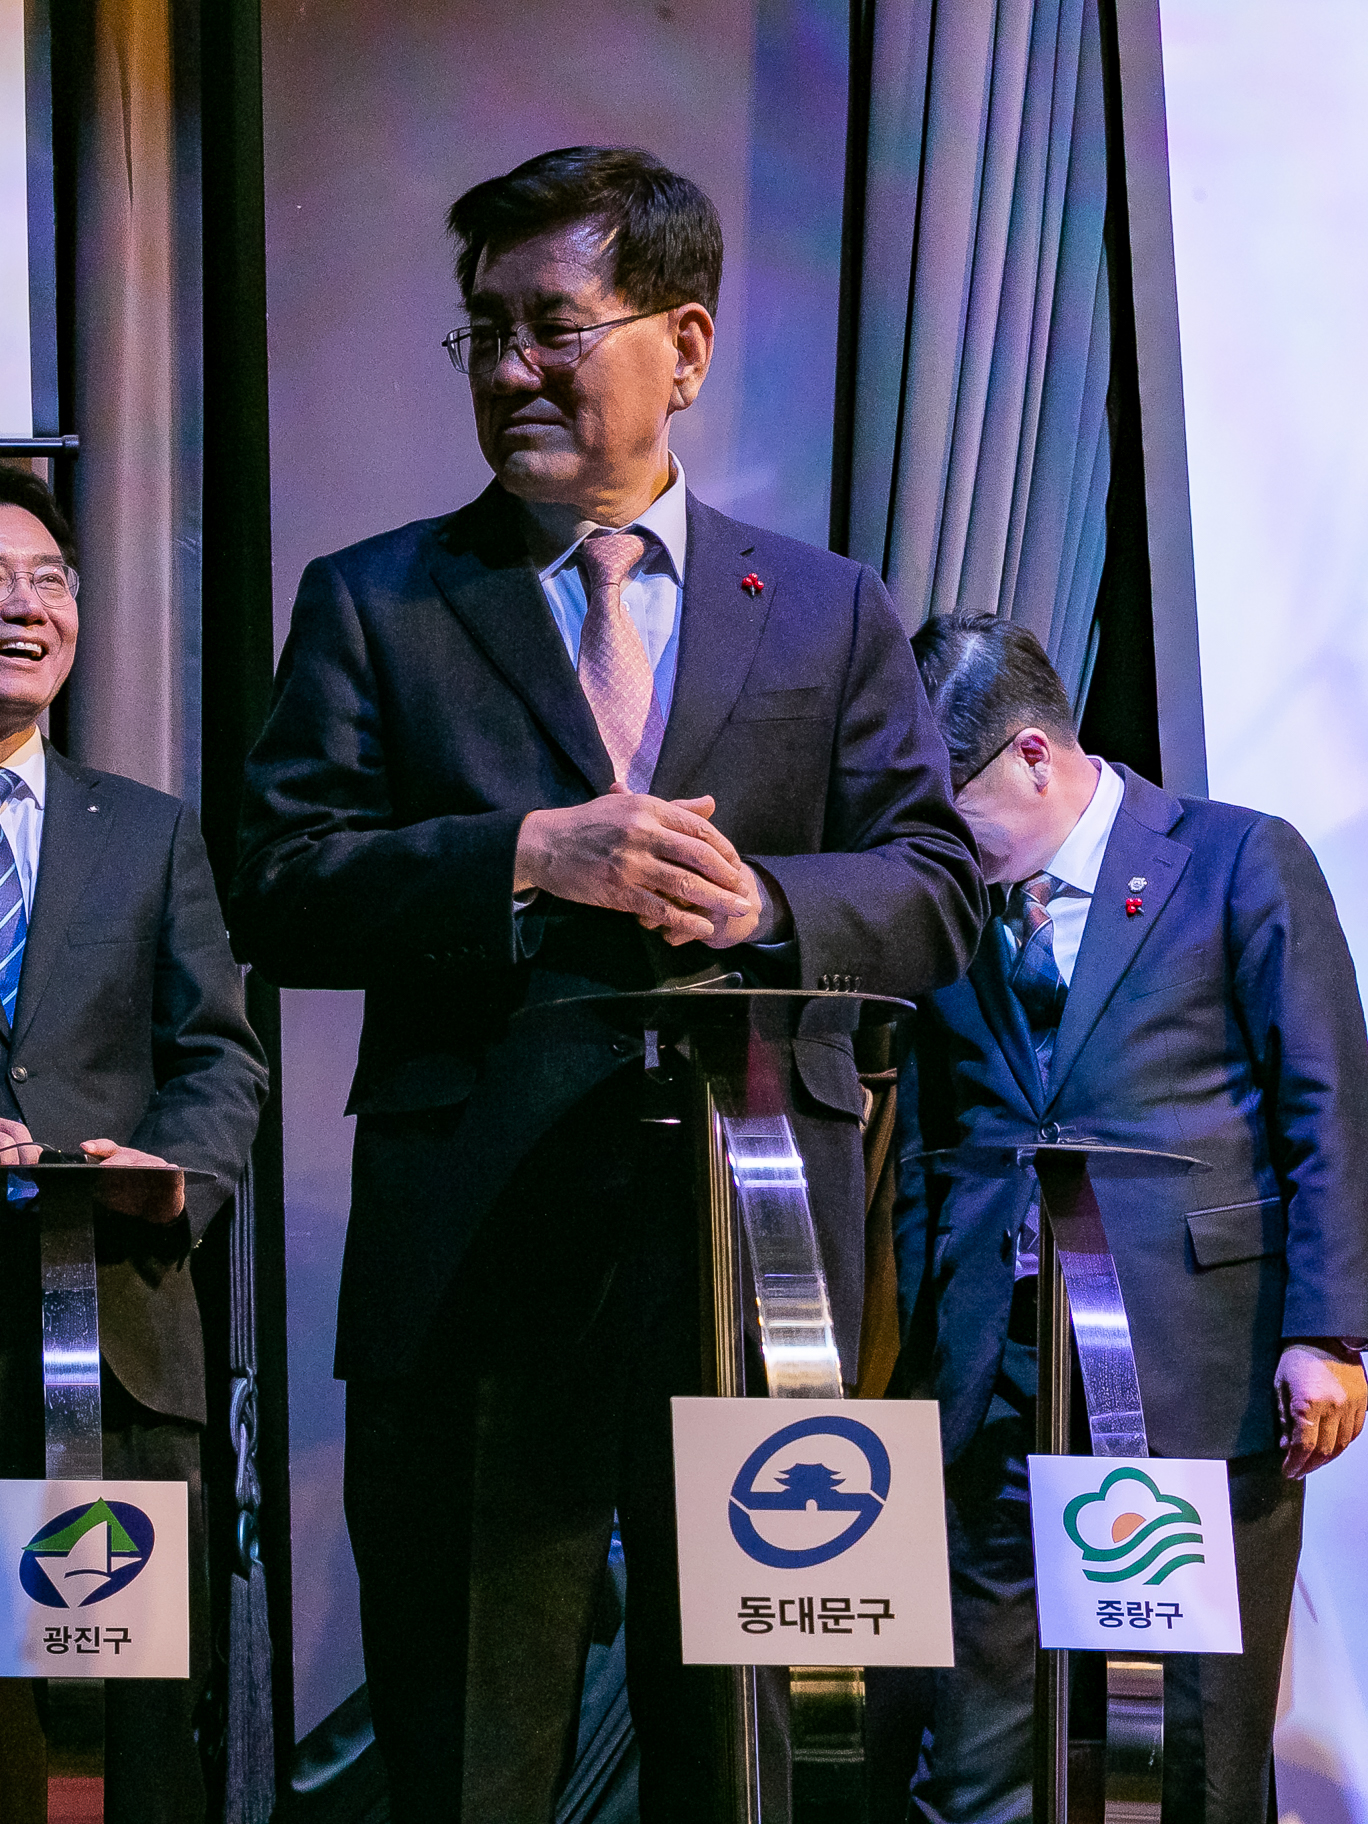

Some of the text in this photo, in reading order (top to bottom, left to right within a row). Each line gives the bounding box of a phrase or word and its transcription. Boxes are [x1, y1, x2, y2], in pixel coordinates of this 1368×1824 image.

[737, 1596, 895, 1637] 동대문구
[1096, 1599, 1184, 1631] 중랑구
[42, 1625, 132, 1655] 광진구
